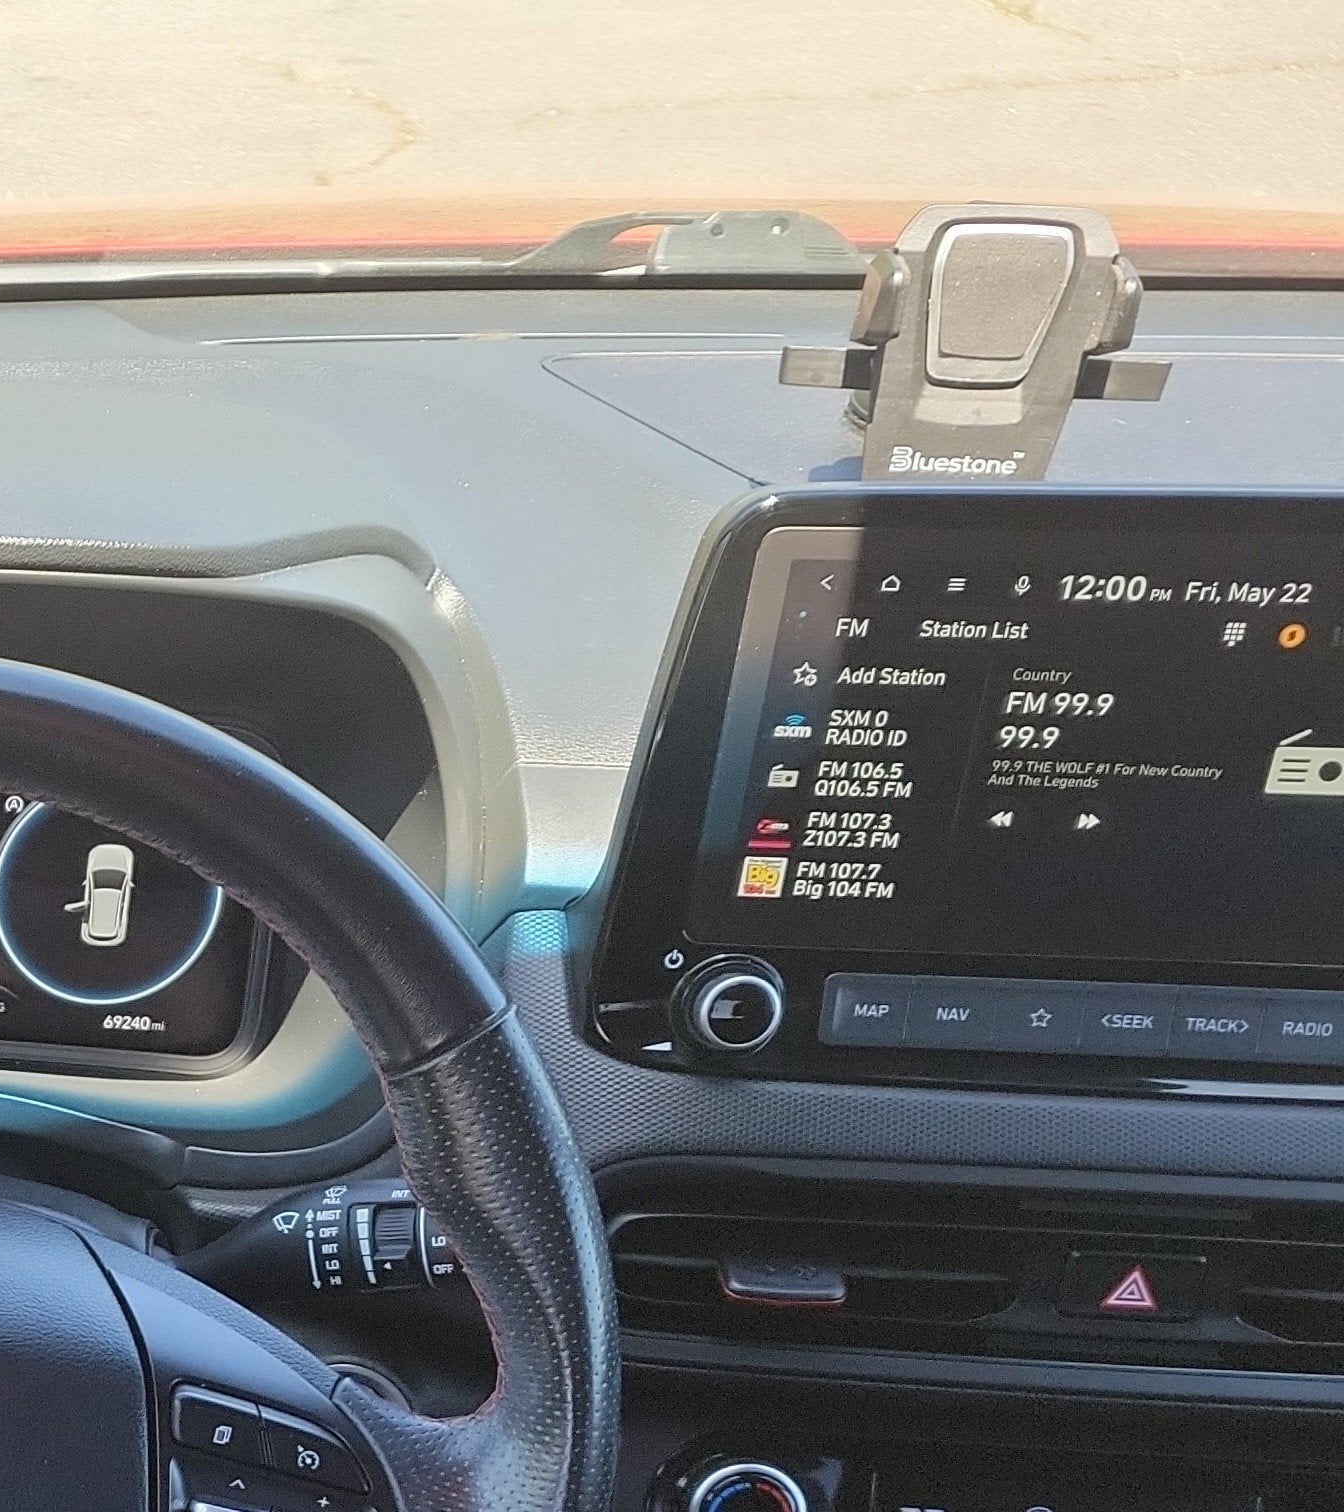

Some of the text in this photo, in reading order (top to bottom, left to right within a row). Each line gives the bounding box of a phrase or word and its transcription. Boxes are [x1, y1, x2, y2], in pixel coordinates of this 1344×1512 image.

[888, 446, 1018, 474] Bluestone
[1061, 574, 1172, 601] 12:00 PM
[1185, 581, 1312, 607] Fri, May 22
[835, 618, 870, 637] FM
[919, 620, 1029, 640] Station List
[837, 667, 946, 687] Add Station
[1013, 667, 1072, 684] Country
[1005, 691, 1114, 716] FM 99.9
[828, 709, 871, 727] SXM
[825, 728, 907, 747] RADIO ID
[999, 725, 1060, 749] 99.9
[818, 761, 904, 779] FM 106.5
[992, 760, 1223, 780] 99.9 THE WOLF #1 For New Country
[814, 780, 913, 798] Q106.5 FM
[988, 774, 1100, 790] And The Legends
[807, 811, 837, 829] FM
[840, 812, 893, 830] 107.3
[802, 830, 901, 849] Z107.3 FM
[796, 861, 882, 880] FM 107.7
[792, 880, 895, 900] Big 104 FM
[853, 1003, 889, 1018] MAP
[936, 1006, 971, 1022] NAV
[1282, 1020, 1333, 1037] RADIO
[317, 1210, 342, 1220] MIST
[319, 1227, 339, 1238] OFF
[433, 1264, 453, 1275] OFF
